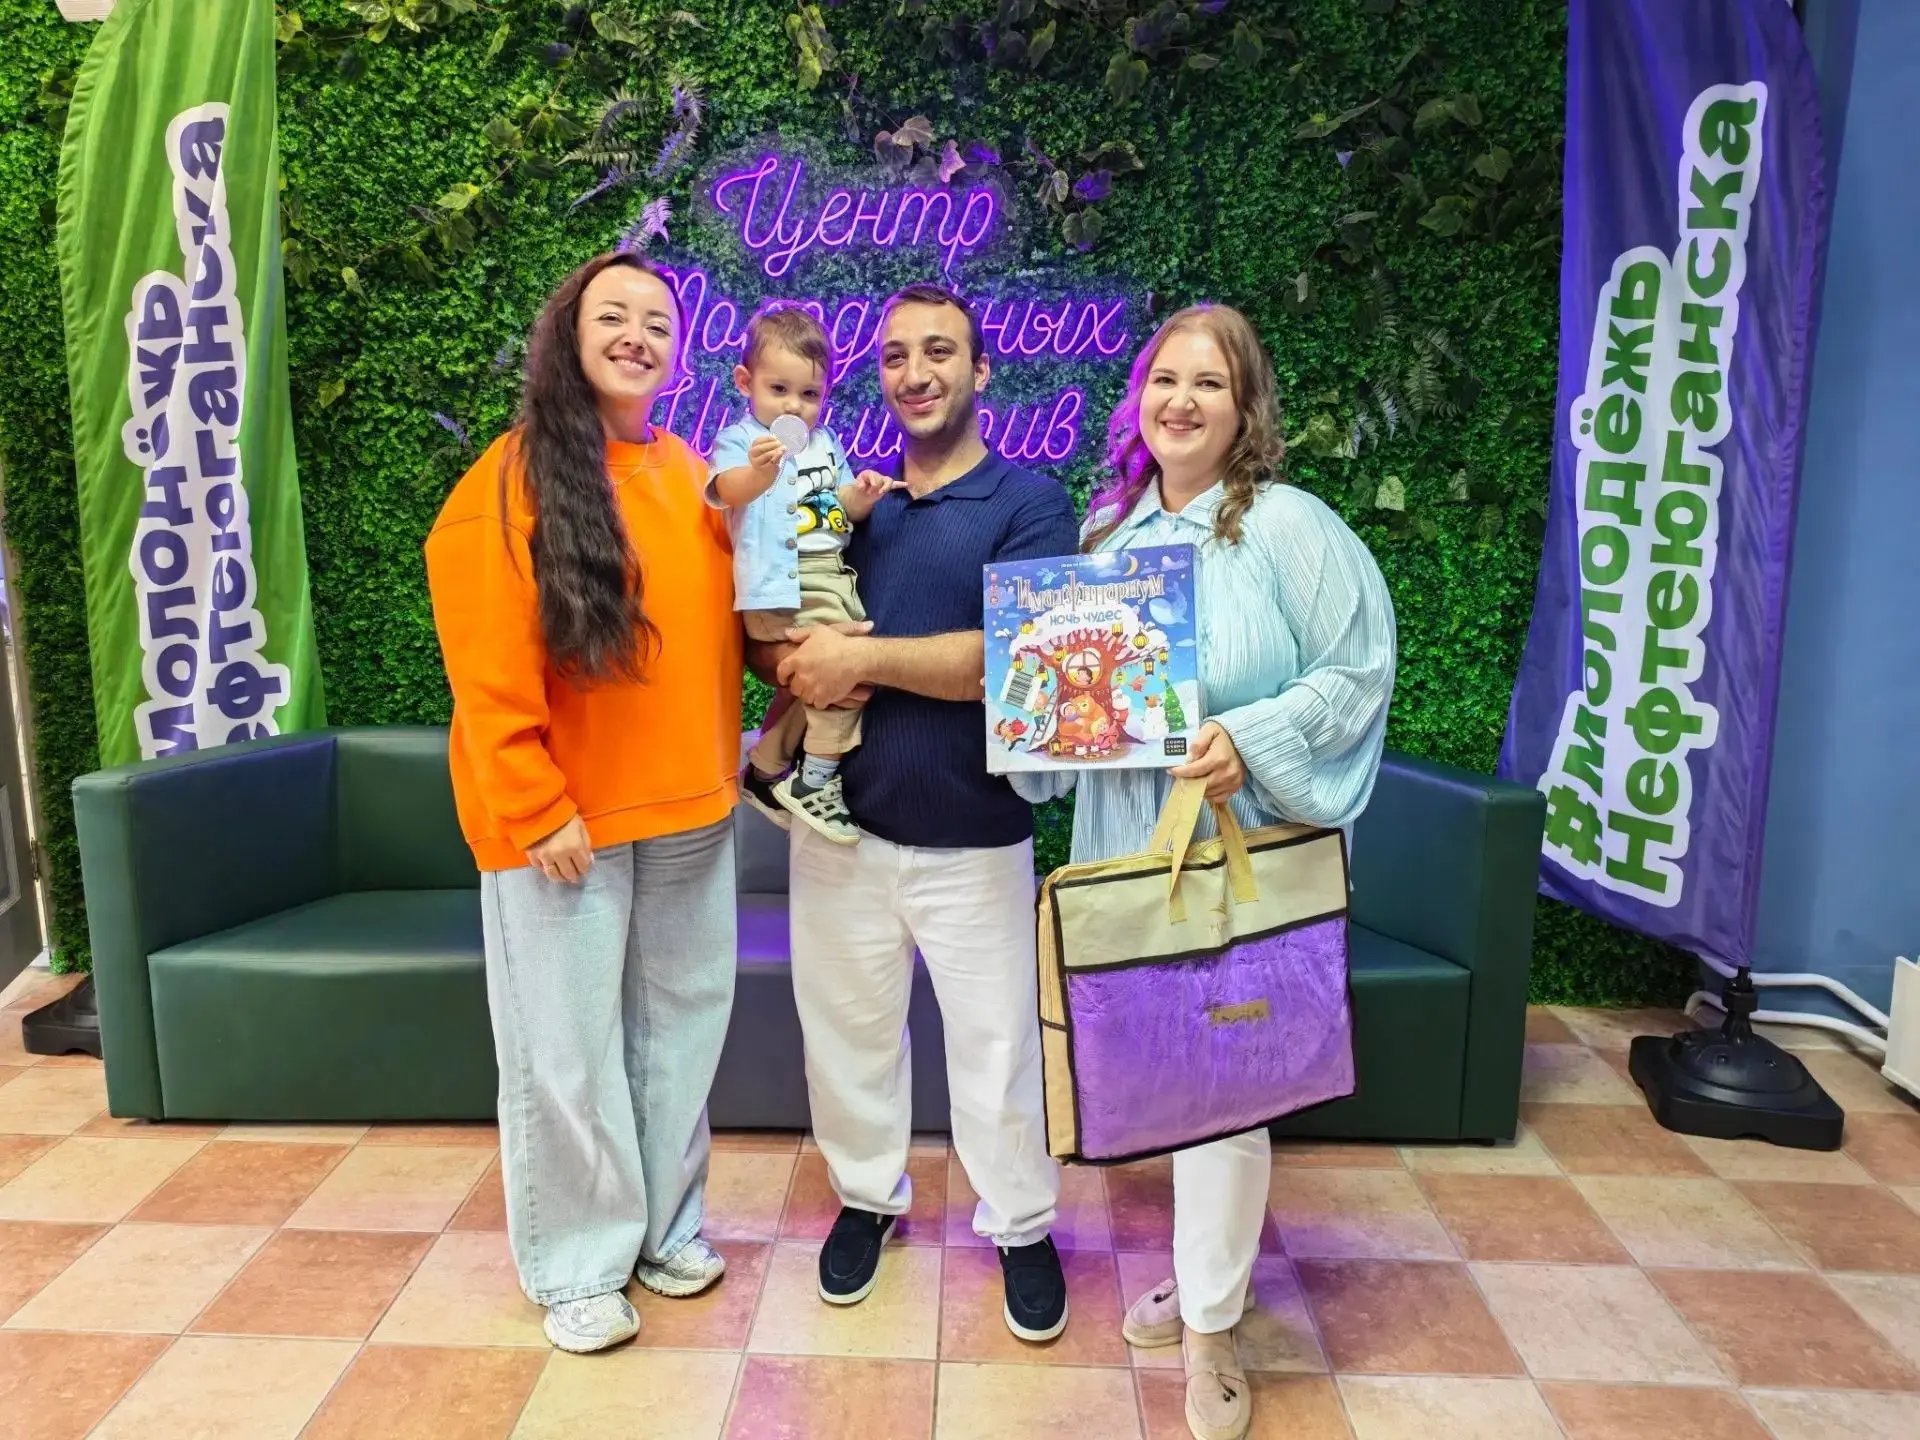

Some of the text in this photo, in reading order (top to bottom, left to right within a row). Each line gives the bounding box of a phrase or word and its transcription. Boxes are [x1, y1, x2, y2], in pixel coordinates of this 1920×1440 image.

[716, 157, 994, 277] Центр
[1606, 98, 1757, 893] Нефтеюганска
[1544, 261, 1661, 866] #молодёжь
